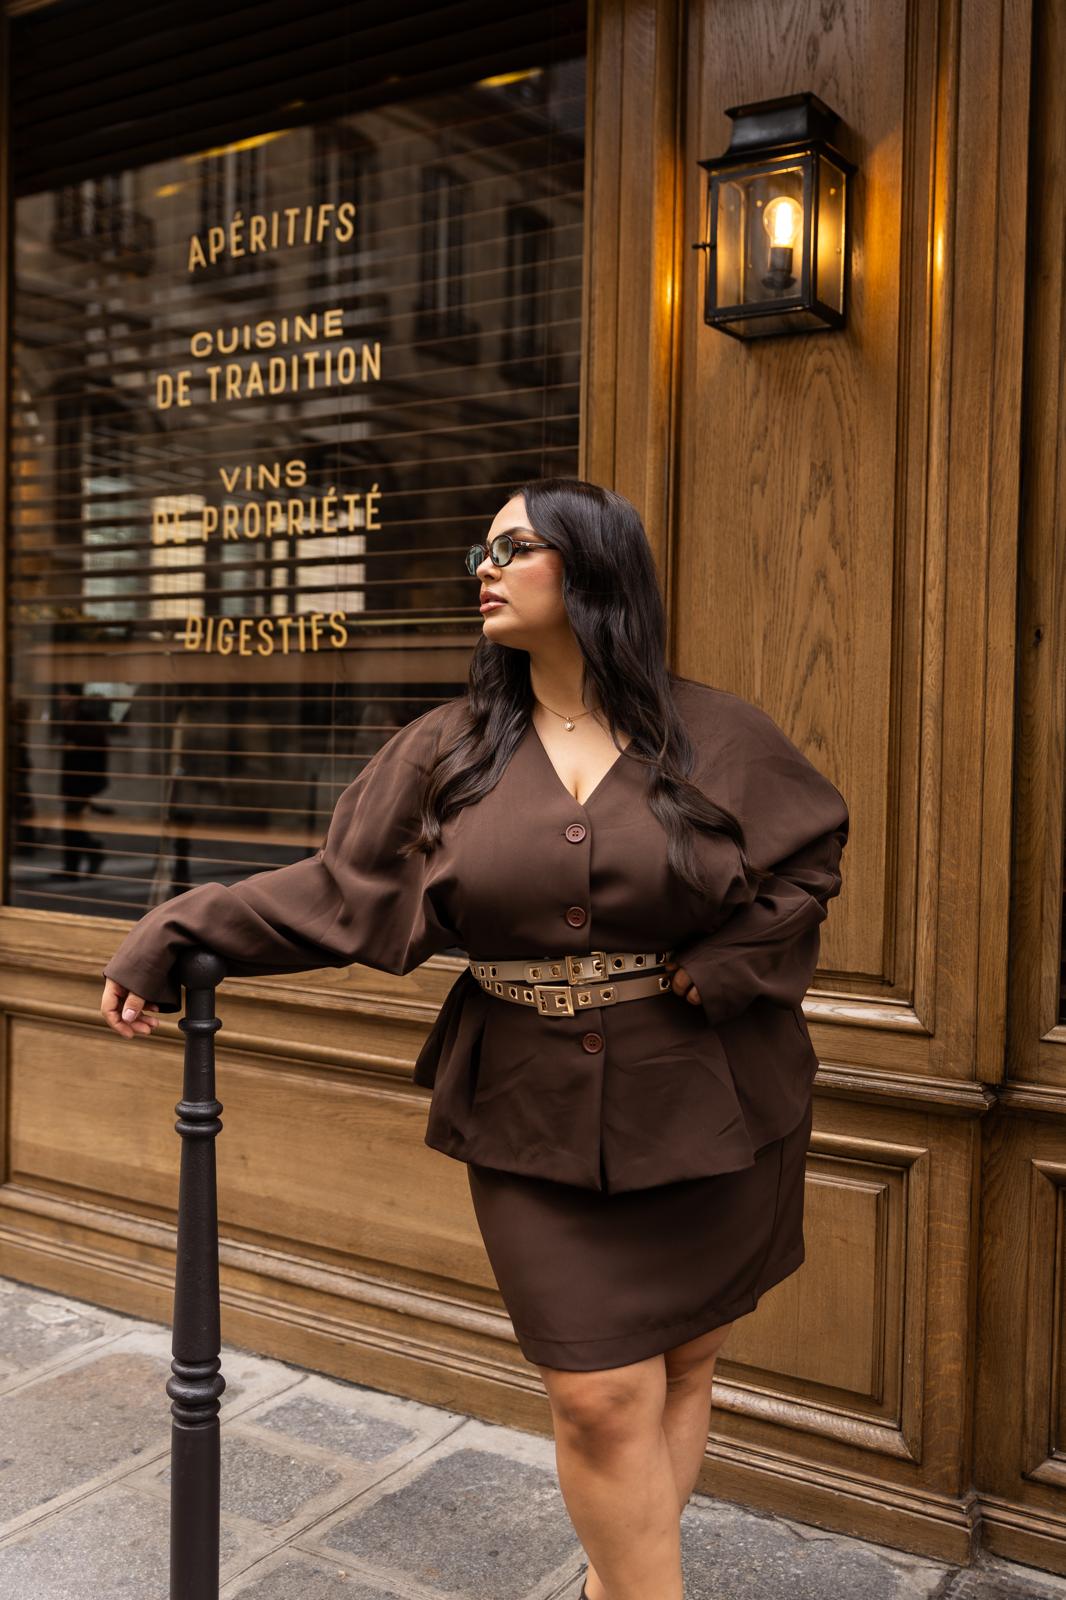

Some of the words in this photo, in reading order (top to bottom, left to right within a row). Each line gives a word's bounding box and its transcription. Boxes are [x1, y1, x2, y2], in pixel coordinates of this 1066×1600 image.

[188, 202, 356, 272] APÉRITIFS
[190, 309, 344, 357] CUISINE
[156, 370, 192, 410] DE
[206, 342, 381, 402] TRADITION
[219, 460, 307, 492] VINS
[202, 483, 382, 542] PROPRIÉTÉ
[184, 611, 348, 656] DIGESTIFS
